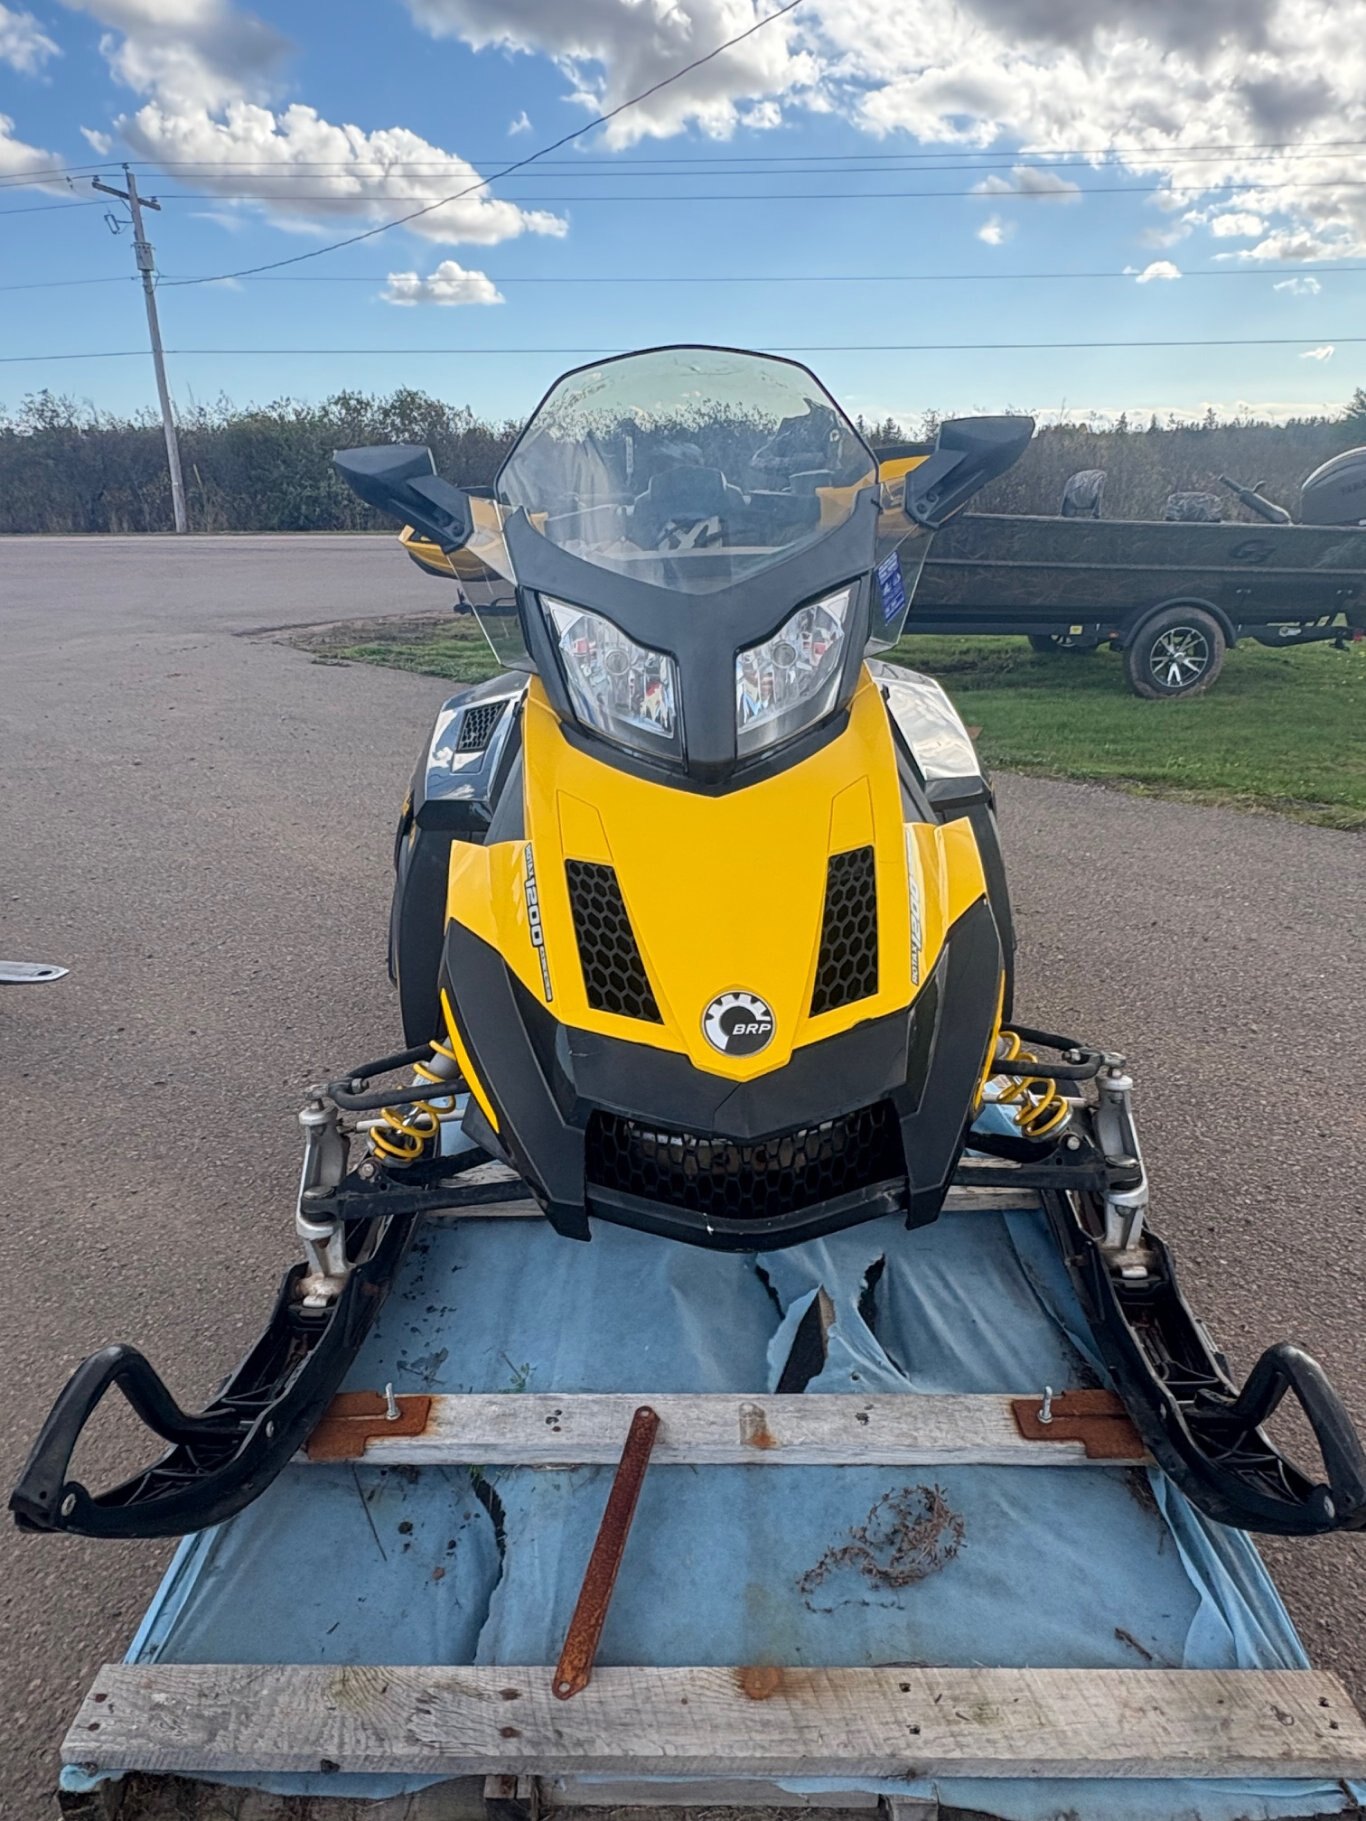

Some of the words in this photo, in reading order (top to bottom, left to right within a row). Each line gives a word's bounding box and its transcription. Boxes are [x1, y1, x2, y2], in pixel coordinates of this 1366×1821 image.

[525, 878, 543, 947] 1200
[909, 881, 922, 951] 1200
[911, 947, 920, 986] ROTAX
[732, 1023, 772, 1036] BRP
